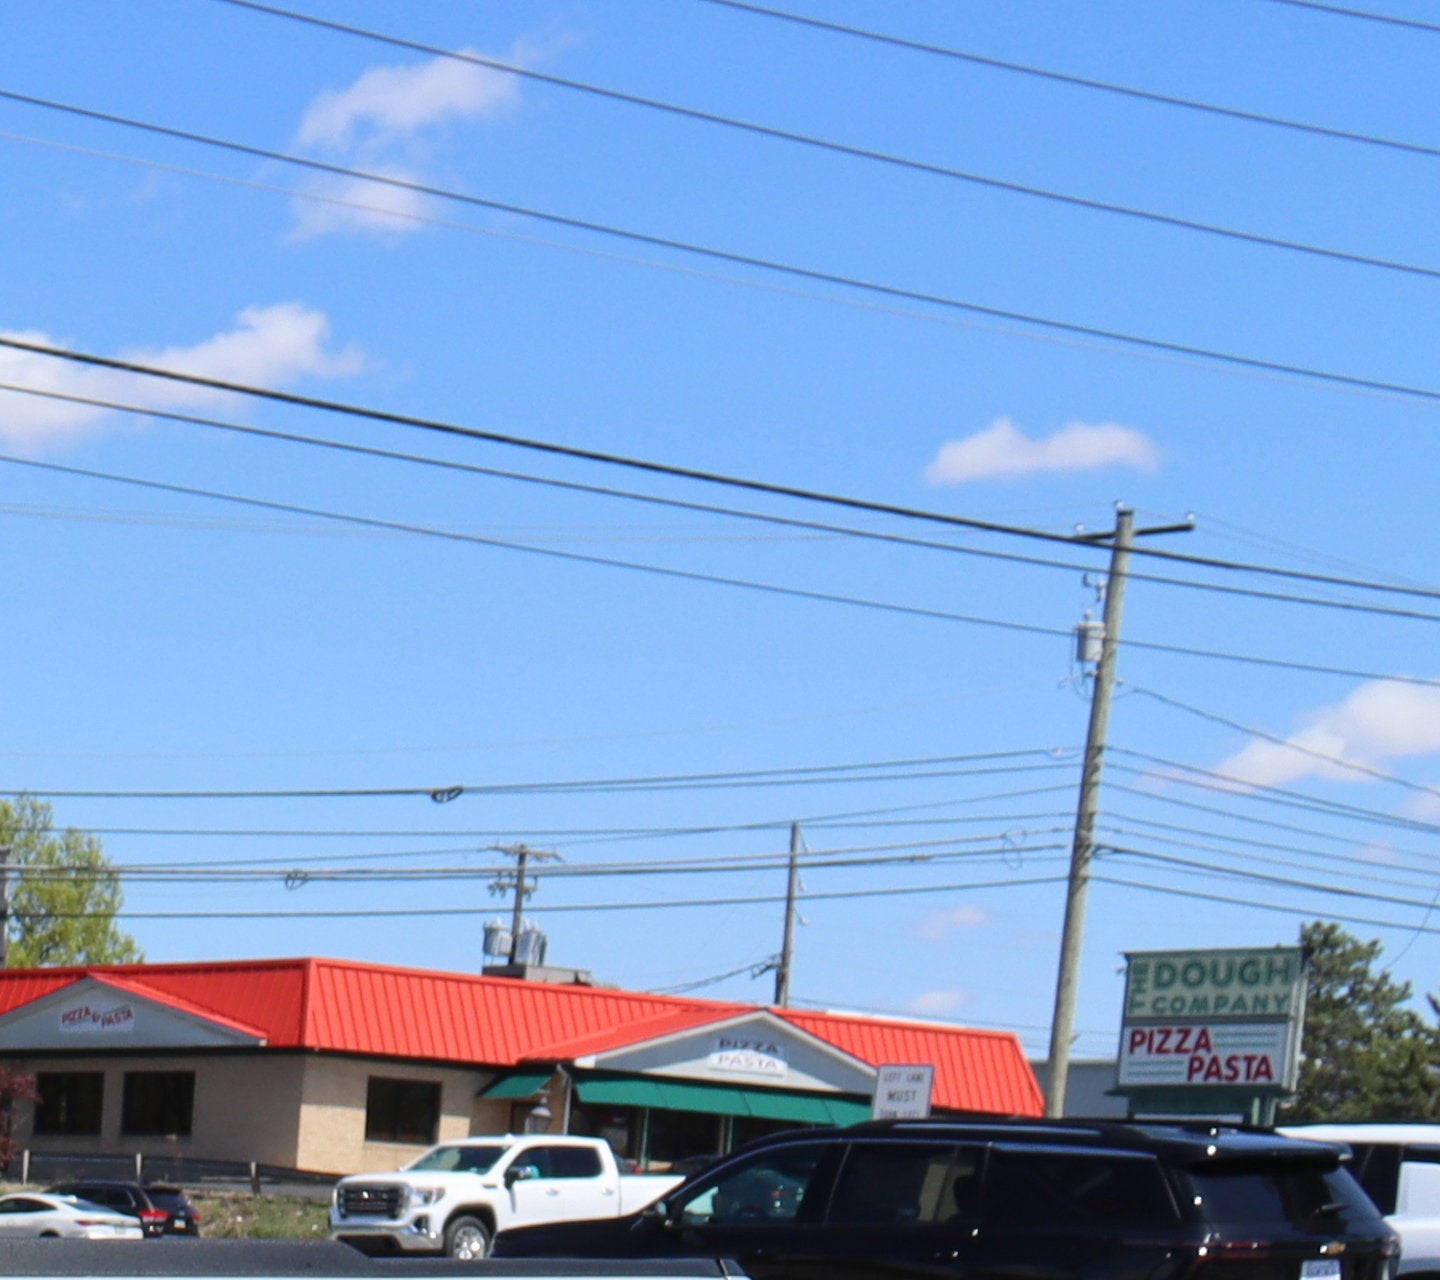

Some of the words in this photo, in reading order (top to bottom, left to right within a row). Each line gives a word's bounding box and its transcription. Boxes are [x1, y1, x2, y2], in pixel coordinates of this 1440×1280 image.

[1154, 956, 1290, 989] DOUGH
[1129, 962, 1150, 1014] THE
[1151, 993, 1291, 1014] COMPANY
[719, 1038, 779, 1052] PIZZA
[1129, 1026, 1212, 1055] PIZZA
[718, 1055, 779, 1069] PASTA
[1187, 1054, 1273, 1082] PASTA
[888, 1089, 917, 1102] MUST
